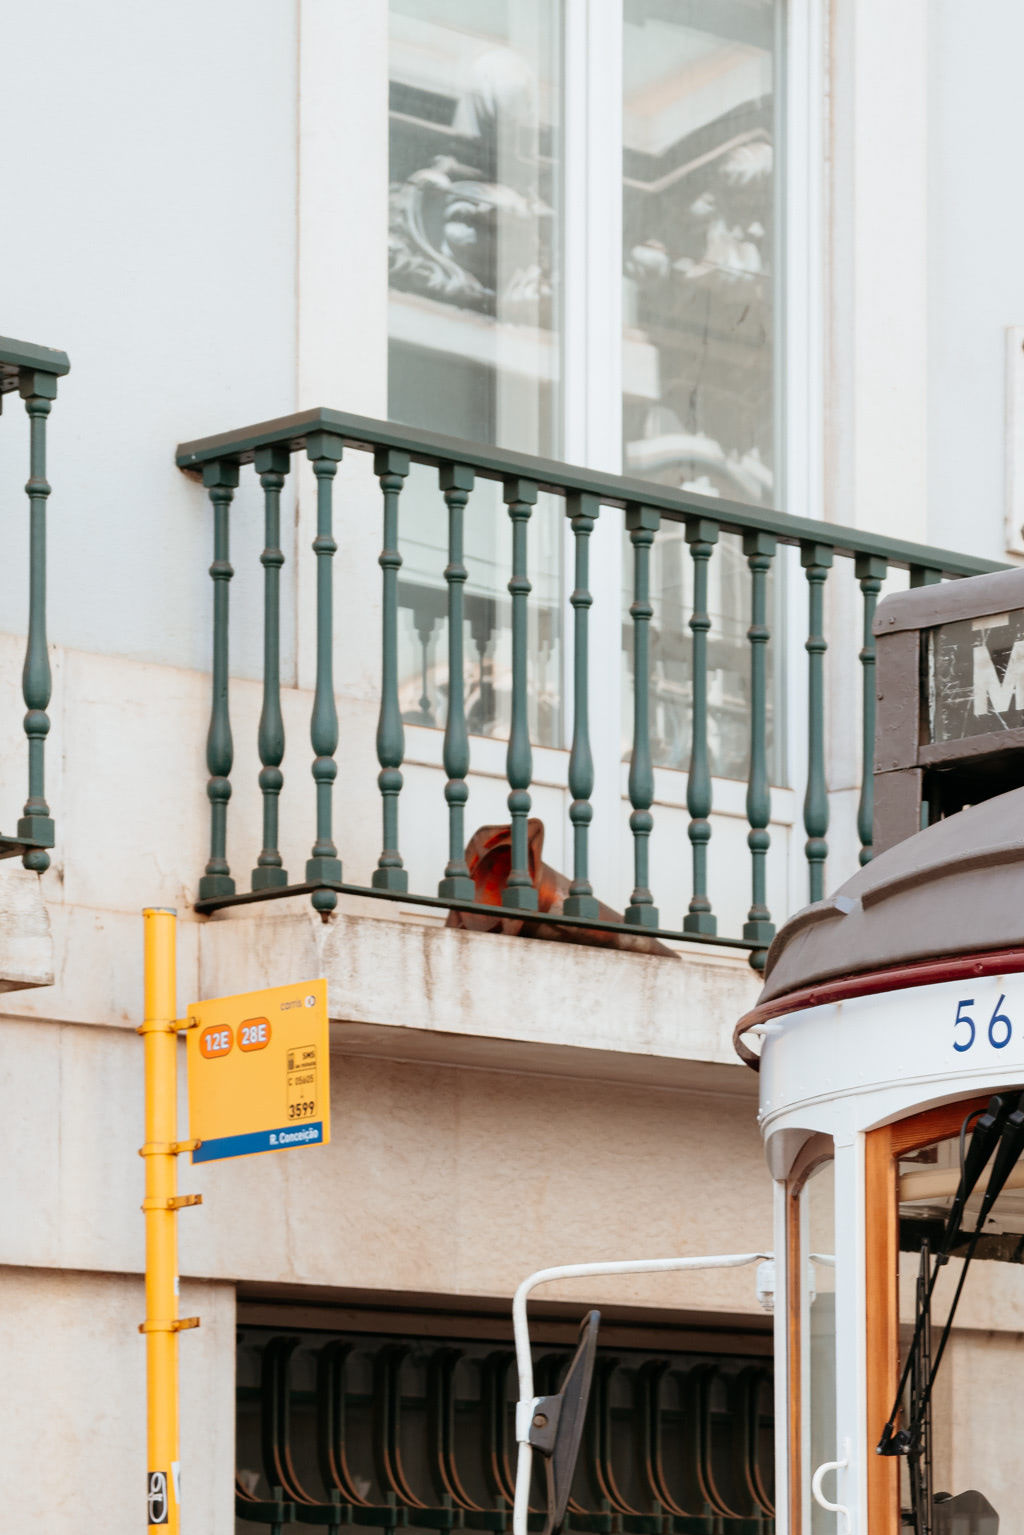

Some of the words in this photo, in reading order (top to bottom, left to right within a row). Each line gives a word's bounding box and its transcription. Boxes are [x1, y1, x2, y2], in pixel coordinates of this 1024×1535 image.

[205, 1031, 230, 1052] 12E
[241, 1024, 267, 1045] 28E
[289, 1101, 315, 1118] 3599
[279, 1127, 319, 1144] Conceição
